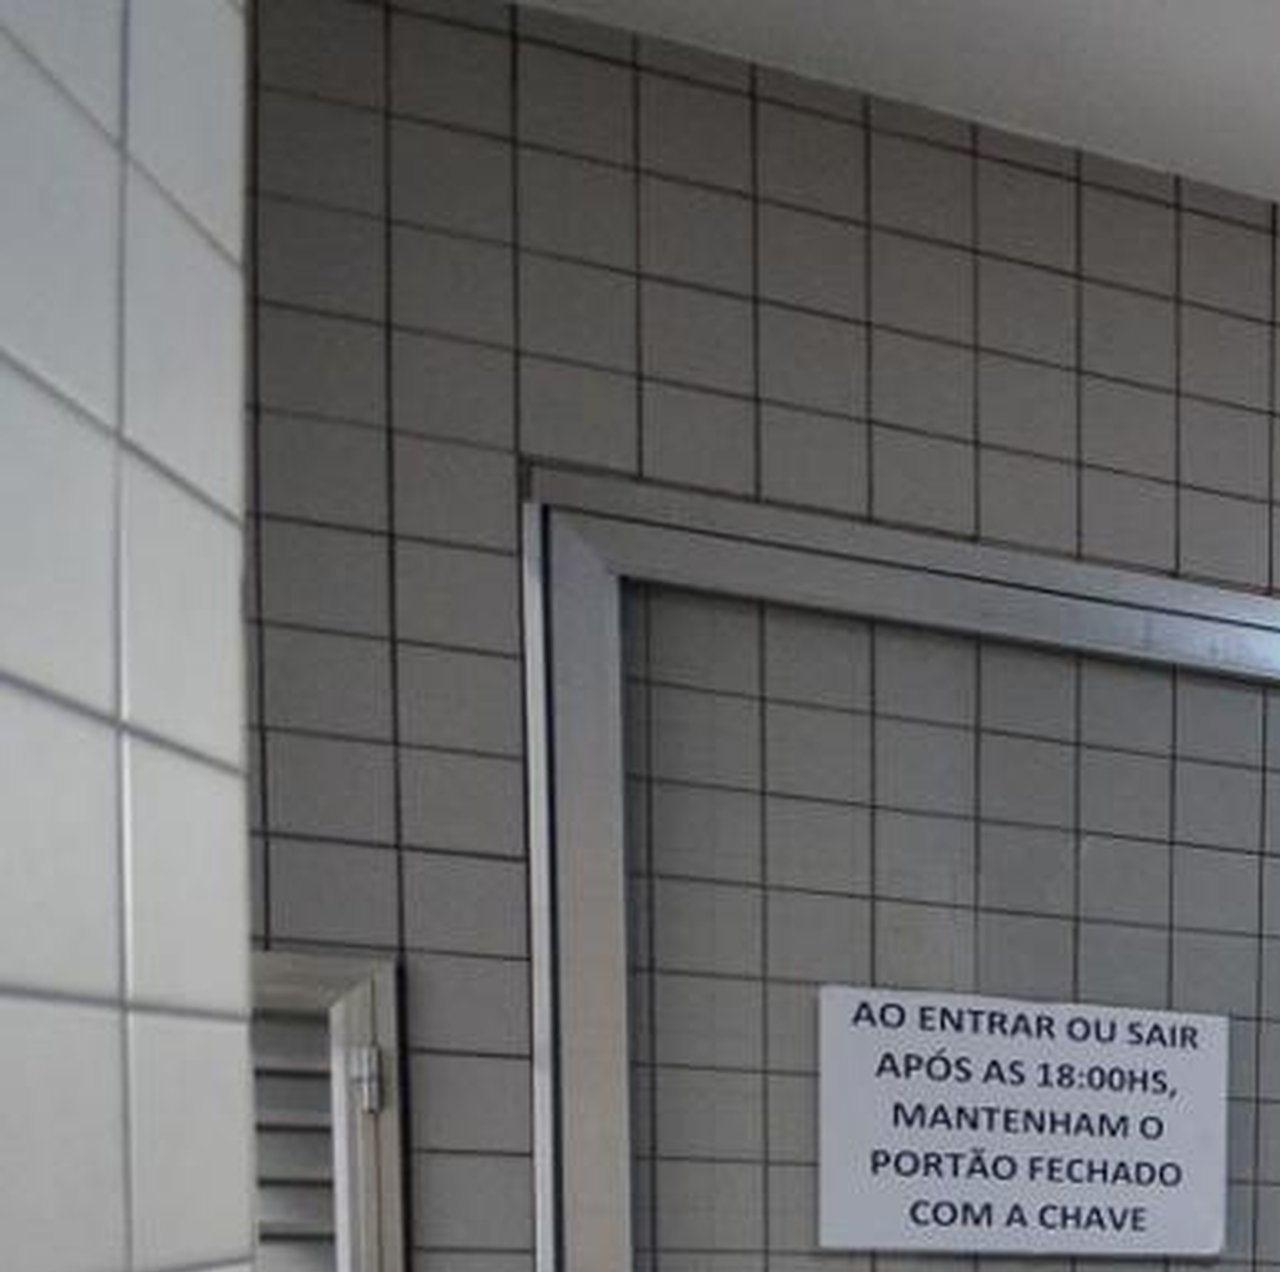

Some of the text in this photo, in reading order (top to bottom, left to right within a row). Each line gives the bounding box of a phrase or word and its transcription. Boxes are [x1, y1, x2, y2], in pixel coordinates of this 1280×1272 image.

[851, 1001, 1199, 1050] AO ENTRAR OU SAIR
[875, 1048, 1178, 1099] APÓS AS 18:00HS,
[892, 1102, 1165, 1141] MANTENHAM O
[870, 1148, 1183, 1188] PORTÃO FECHADO
[909, 1199, 1147, 1232] COM A CHAVE
